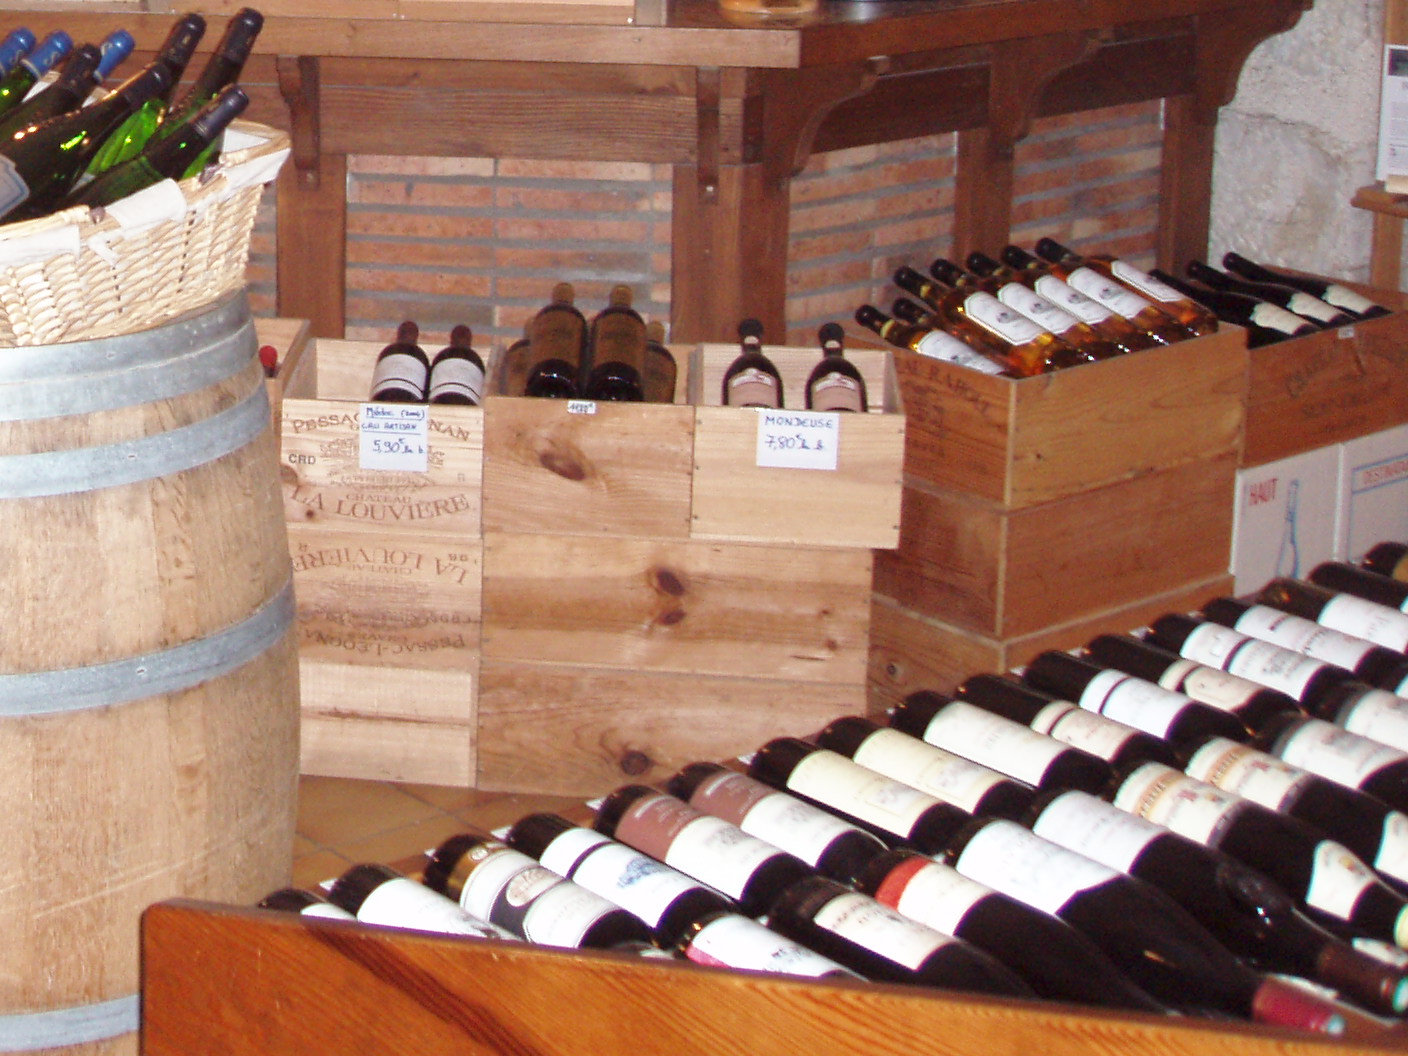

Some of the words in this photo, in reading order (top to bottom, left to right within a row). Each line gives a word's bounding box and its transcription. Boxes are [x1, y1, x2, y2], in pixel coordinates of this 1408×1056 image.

[765, 416, 833, 429] MONDEUSE
[288, 454, 316, 465] CRD
[290, 485, 324, 510] LA
[435, 557, 469, 585] LA
